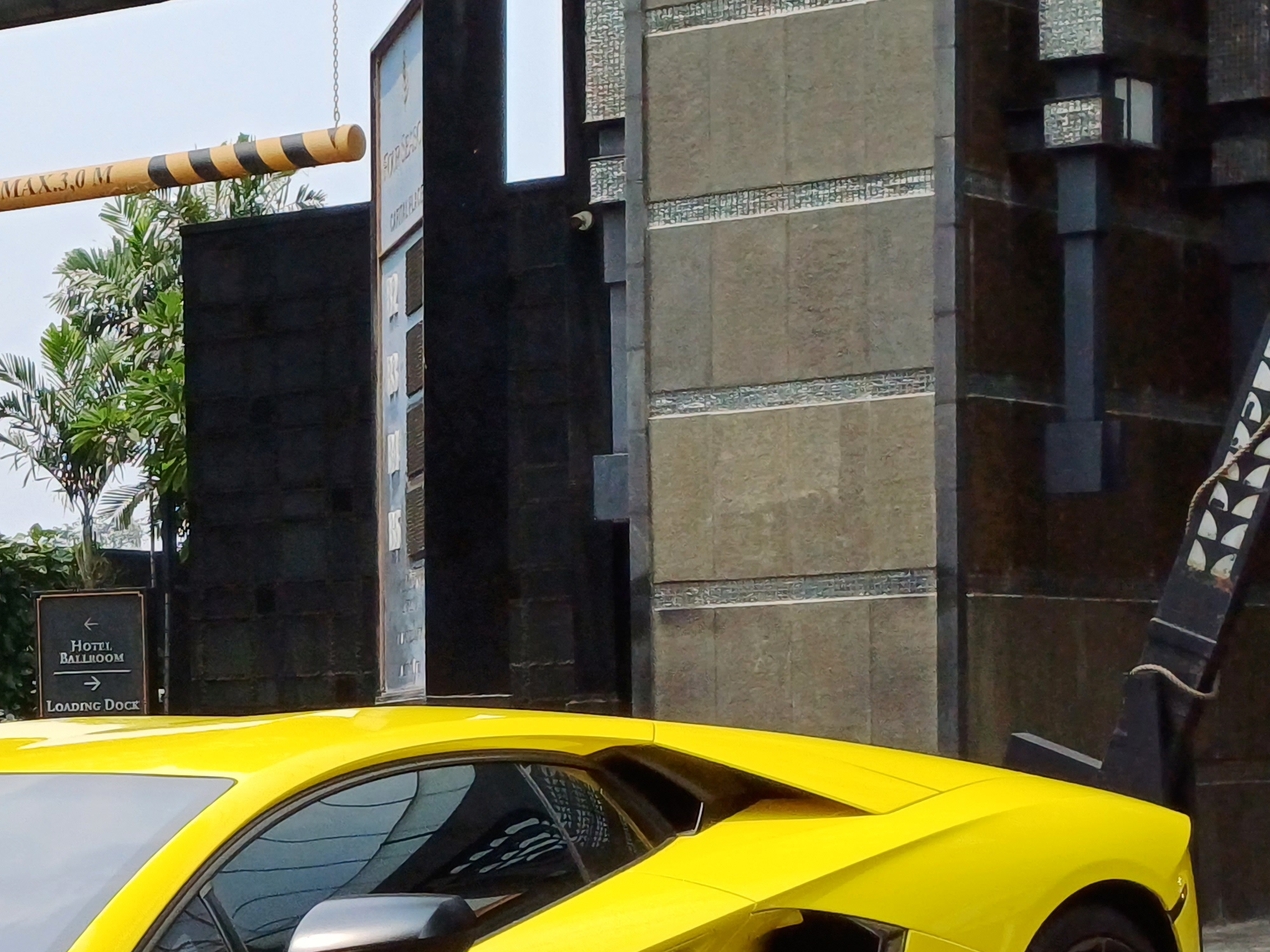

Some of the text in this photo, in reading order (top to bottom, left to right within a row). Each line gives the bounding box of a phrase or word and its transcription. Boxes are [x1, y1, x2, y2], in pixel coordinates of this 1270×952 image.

[93, 165, 114, 186] M
[70, 639, 112, 653] HOTEL
[59, 652, 124, 664] BALLROOM
[46, 698, 140, 712] LOADING DOCK
